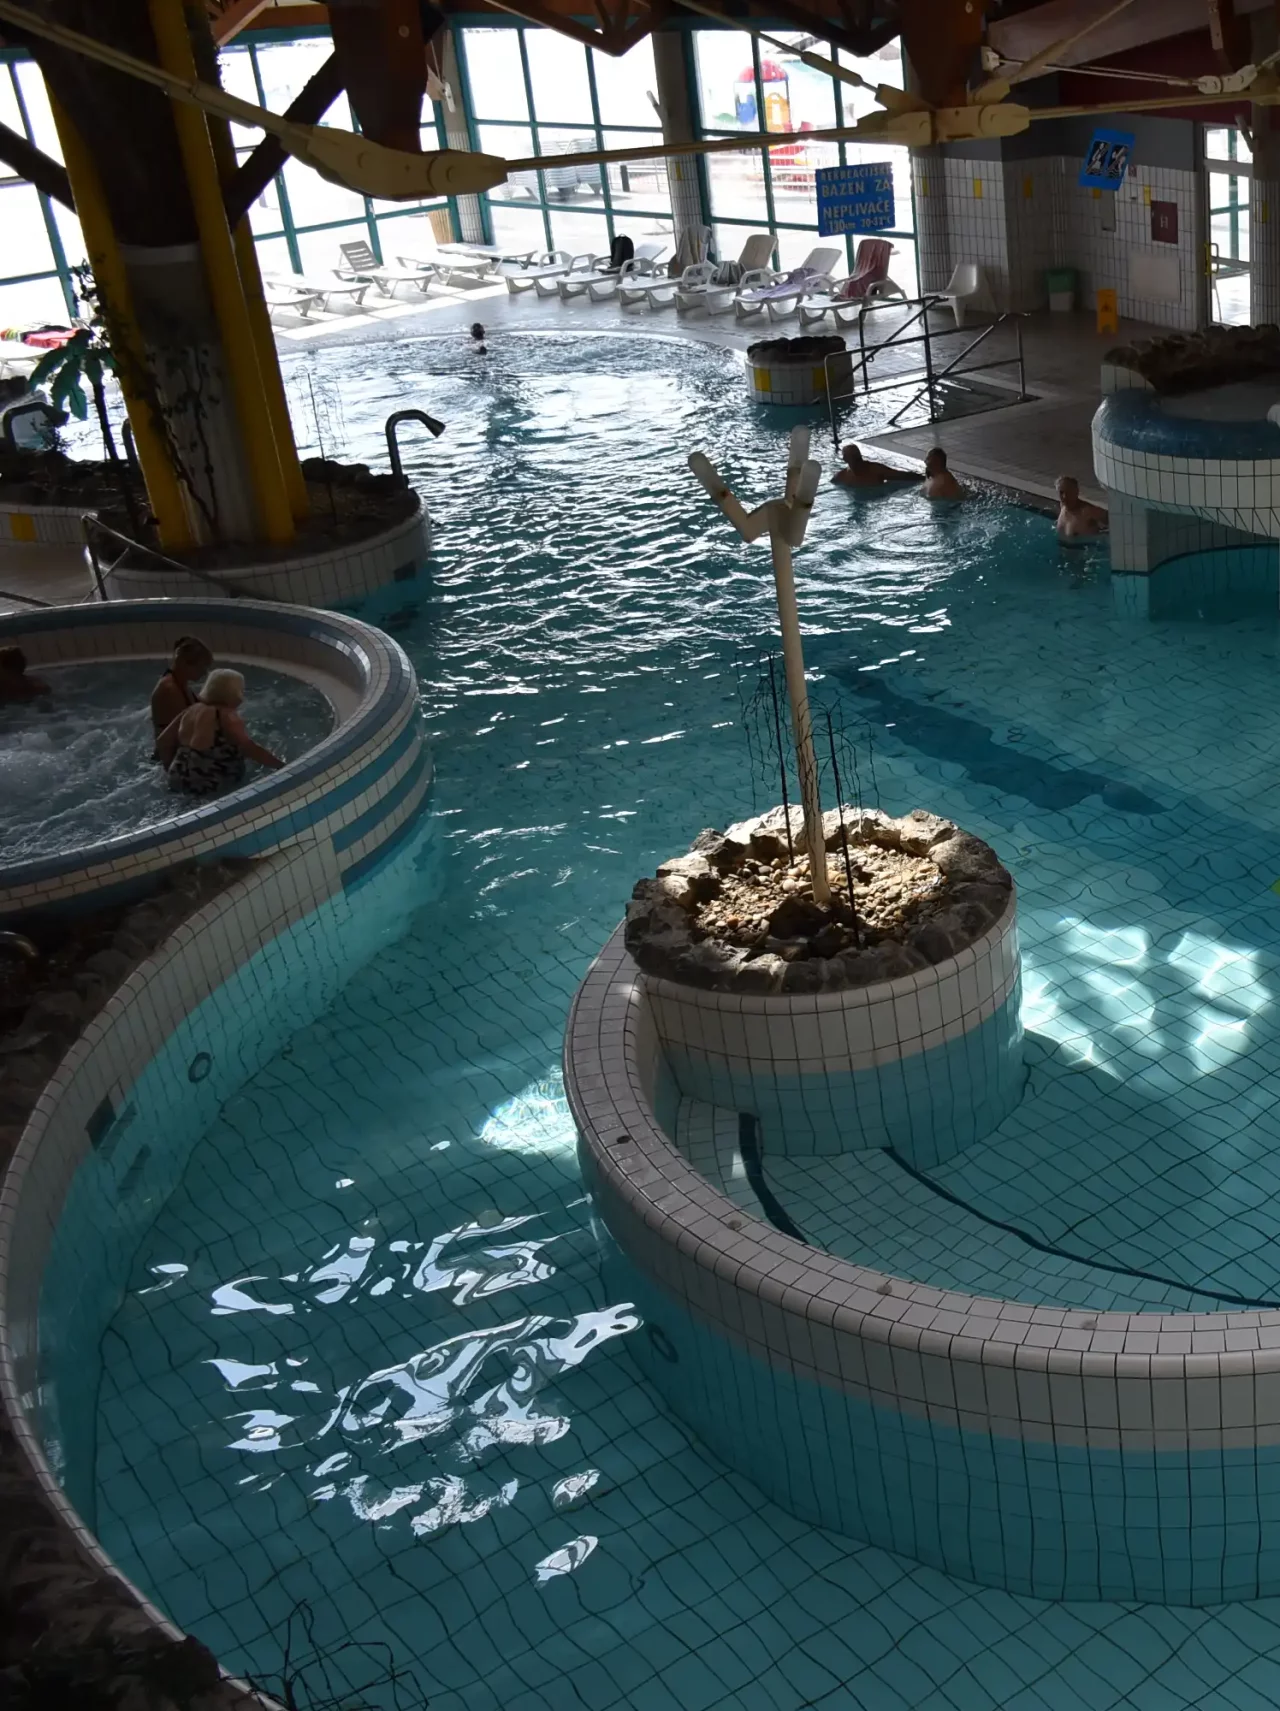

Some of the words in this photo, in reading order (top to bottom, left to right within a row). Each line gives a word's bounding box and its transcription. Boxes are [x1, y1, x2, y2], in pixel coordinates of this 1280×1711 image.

[821, 180, 865, 198] BAZEN
[874, 178, 891, 192] ZA
[822, 196, 891, 220] NEPLIVAČE
